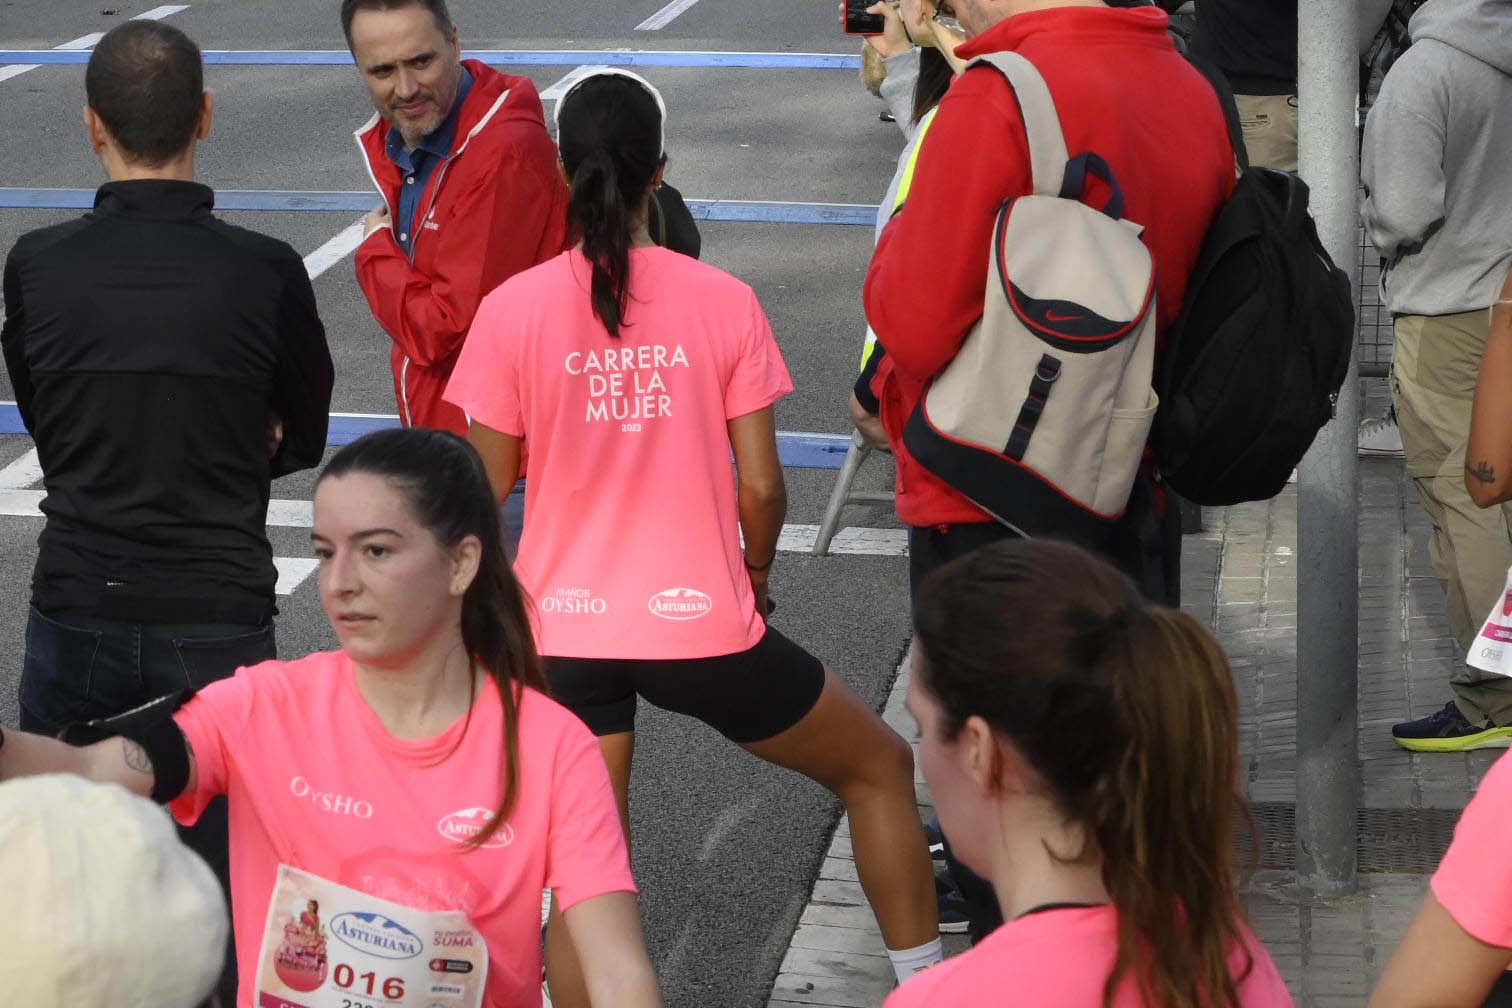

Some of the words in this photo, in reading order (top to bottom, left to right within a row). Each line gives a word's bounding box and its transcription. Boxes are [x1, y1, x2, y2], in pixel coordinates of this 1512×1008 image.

[565, 344, 690, 375] CARRERA
[589, 370, 623, 397] DE
[634, 369, 667, 393] LA
[586, 394, 672, 423] MUJER
[542, 596, 607, 614] OYSHO
[290, 776, 373, 819] OYSHO
[338, 920, 416, 955] ASTURIANA
[433, 936, 473, 947] SUMA
[333, 963, 406, 1000] 016
